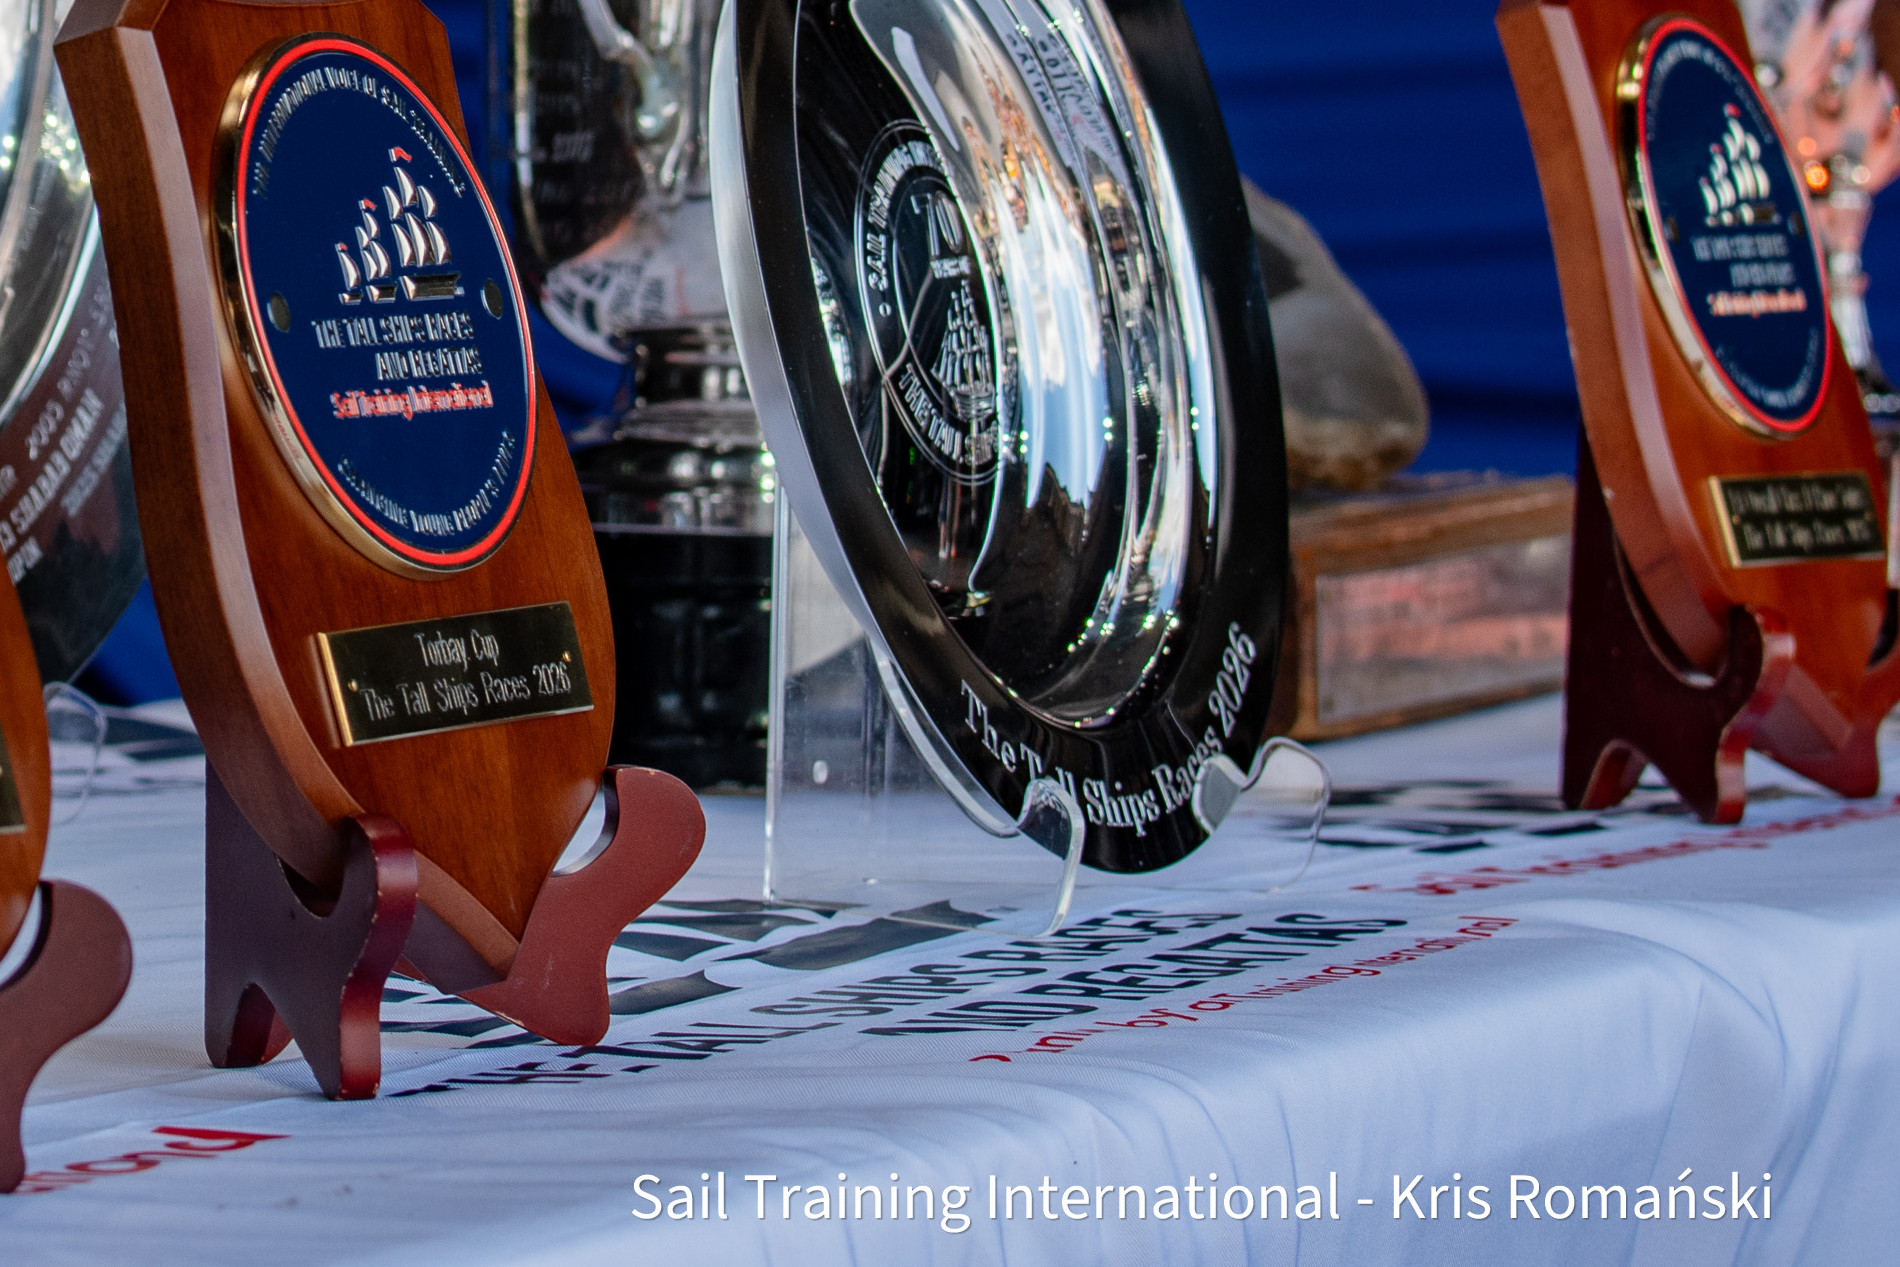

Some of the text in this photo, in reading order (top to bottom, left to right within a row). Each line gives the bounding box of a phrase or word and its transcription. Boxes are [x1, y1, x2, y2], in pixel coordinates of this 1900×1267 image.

[311, 312, 474, 348] THE TALL SHIPS RACES
[375, 346, 482, 381] AND REGATTAS
[59, 385, 104, 462] OMAN
[414, 629, 499, 672] Torbay Cup
[360, 661, 572, 722] The Tall Ships Races 2026
[961, 679, 1017, 773] The
[1020, 742, 1078, 802] Tll
[1083, 778, 1160, 838] Ships
[1208, 621, 1257, 738] 2026
[557, 1022, 843, 1060] TALL
[750, 964, 1048, 1017] SHIPS
[957, 910, 1242, 962] RACES
[857, 913, 1407, 1036] AND REGATTAS
